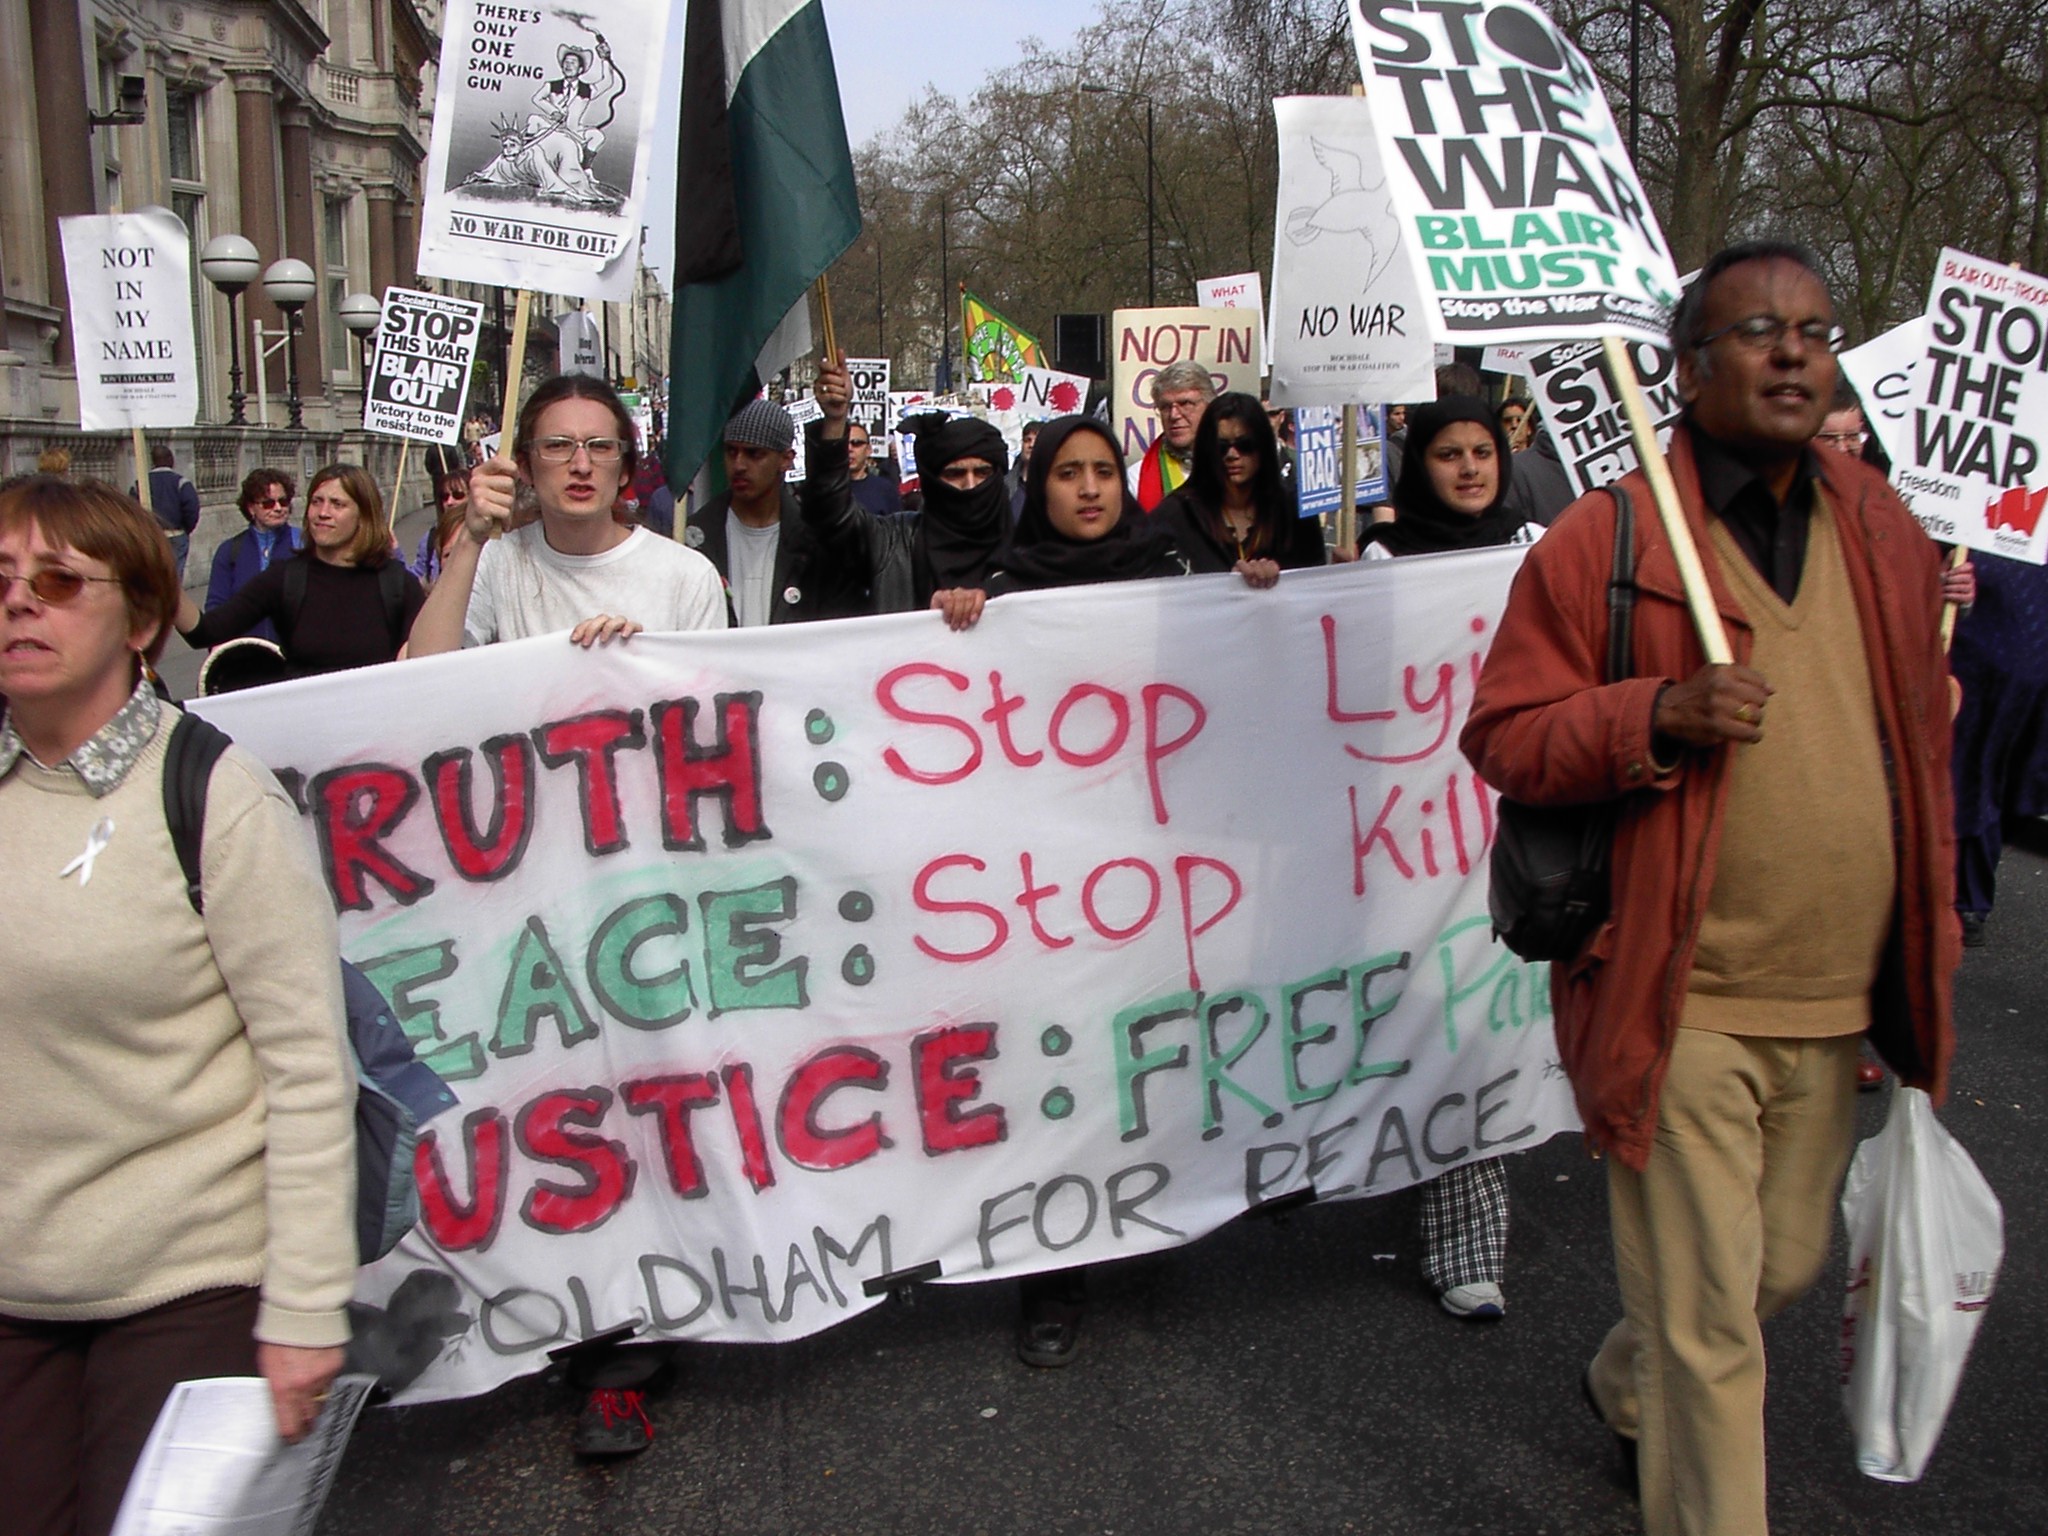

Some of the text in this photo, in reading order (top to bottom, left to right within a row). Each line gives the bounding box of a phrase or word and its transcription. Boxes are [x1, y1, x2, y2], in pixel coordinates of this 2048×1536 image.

[475, 3, 542, 24] THERE'S
[473, 20, 518, 38] ONLY
[471, 38, 516, 59] ONE
[467, 75, 502, 92] GUN
[468, 58, 545, 80] SMOKING
[1373, 62, 1599, 150] THE
[1393, 134, 1663, 258] WAR
[449, 216, 617, 254] NO WAR FOR OIL!
[1415, 211, 1622, 252] BLAIR
[102, 246, 156, 269] NOT
[1426, 250, 1624, 293] MUST
[115, 281, 143, 301] IN
[397, 294, 469, 315] Socialist Worker
[1211, 284, 1247, 299] WHAT
[115, 310, 150, 329] MY
[1299, 303, 1406, 340] NO WAR
[1440, 299, 1501, 320] Stop
[1502, 297, 1548, 316] the
[1548, 294, 1602, 314] War
[384, 305, 475, 344] STOP
[102, 340, 173, 360] NAME
[381, 333, 470, 363] THIS WAR
[1120, 324, 1252, 366] NOT IN
[380, 353, 461, 389] BLAIR
[848, 370, 886, 390] OP
[1546, 341, 1677, 424] STO
[1926, 346, 2024, 426] THE
[389, 379, 444, 408] OUT
[857, 390, 886, 402] WAR
[371, 402, 456, 428] Victory to the
[375, 418, 444, 439] resistance
[1300, 429, 1332, 452] IN
[1914, 407, 2038, 488] WAR
[1300, 446, 1337, 493] IRAQ
[1897, 470, 1961, 500] Freedom
[280, 614, 1486, 914] RUTH: Stop Lyi
[353, 770, 1495, 1082] EACE: Stop Kill
[411, 1021, 1076, 1253] USTICE:
[1112, 950, 1412, 1142] FREE
[479, 1068, 1536, 1356] OLDHAM FOR PEACE
